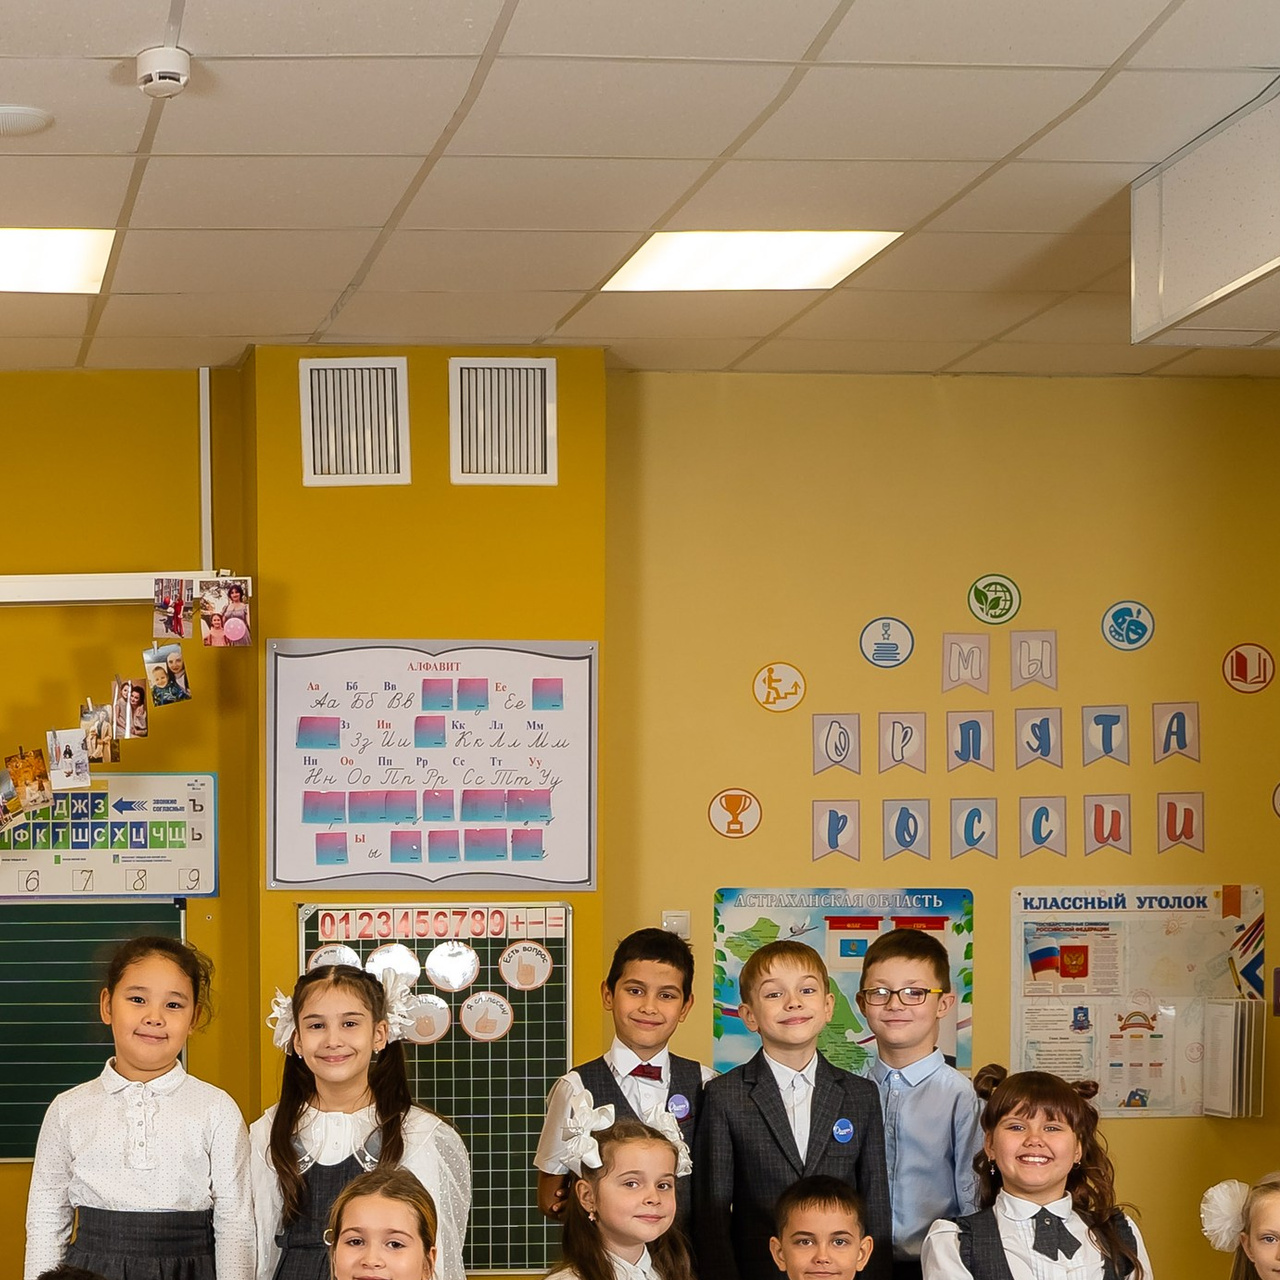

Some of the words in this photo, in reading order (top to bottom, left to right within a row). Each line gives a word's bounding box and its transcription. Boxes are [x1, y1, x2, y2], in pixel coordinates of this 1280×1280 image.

[407, 662, 462, 671] АЛФАВИТ
[307, 682, 320, 691] Аа
[346, 682, 358, 691] Бб
[384, 682, 397, 691] Вв
[495, 682, 507, 692] Ее
[340, 720, 351, 729] Зз
[377, 720, 391, 729] Ии
[451, 720, 466, 730] Кк
[489, 720, 504, 730] Лл
[526, 720, 544, 730] Мм
[303, 756, 318, 766] Нн
[340, 756, 354, 766] Оо
[378, 757, 392, 766] Пп
[416, 757, 428, 768] Рр
[452, 757, 465, 766] Сс
[490, 757, 502, 766] Тт
[529, 757, 543, 769] Уу
[189, 798, 204, 813] Ъ
[25, 870, 39, 891] 6
[80, 869, 93, 891] 7
[132, 869, 147, 891] 8
[186, 868, 200, 890] 9
[734, 893, 863, 908] АСТРАХАНСКАЯ
[866, 893, 943, 908] ОБЛАСТЬ
[1023, 893, 1127, 910] КЛАССНЫЙ
[1135, 895, 1208, 909] УГОЛОК
[503, 949, 519, 963] Есть
[522, 946, 548, 963] вопрос
